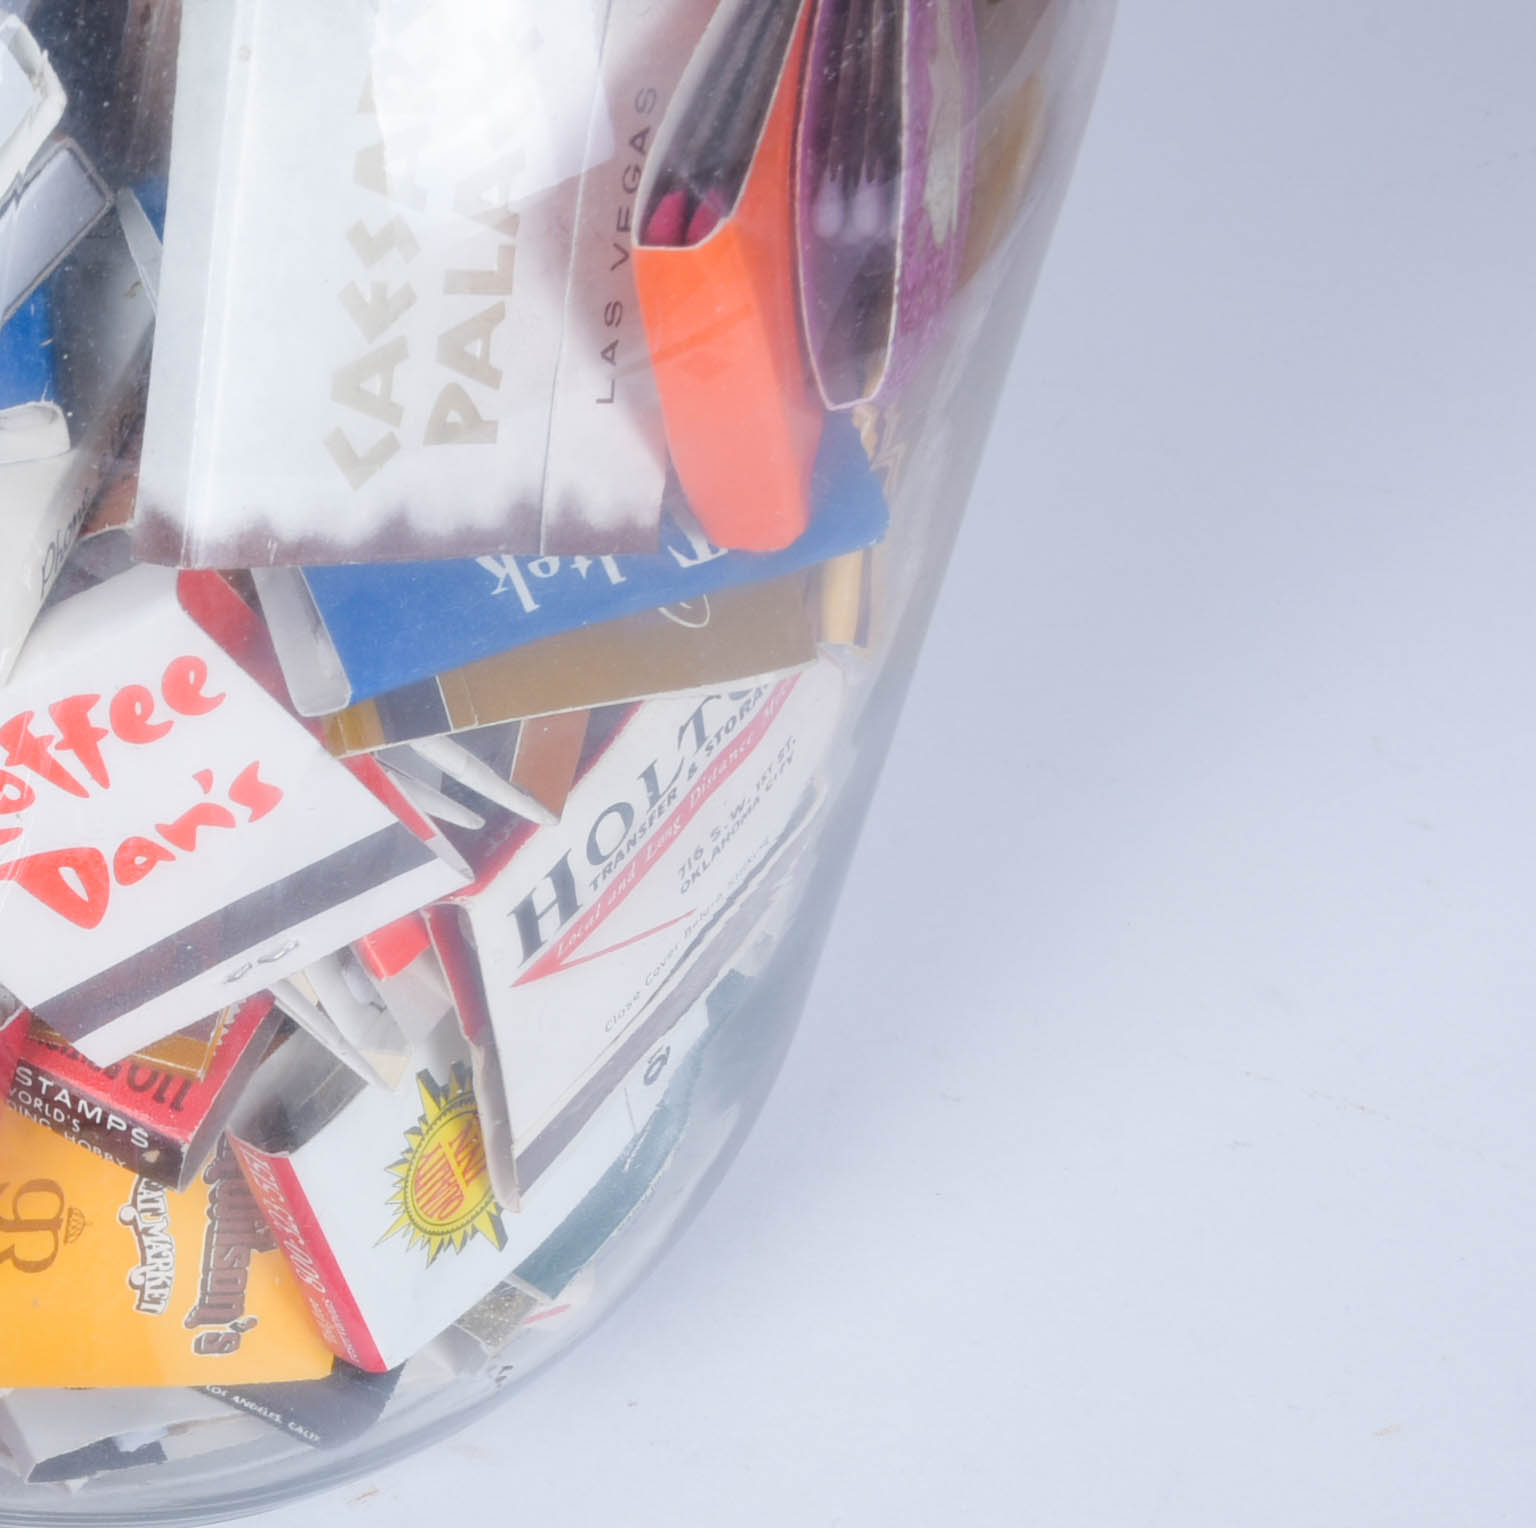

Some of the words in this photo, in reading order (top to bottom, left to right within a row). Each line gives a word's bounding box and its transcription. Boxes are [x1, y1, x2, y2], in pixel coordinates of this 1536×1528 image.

[595, 299, 623, 405] LAS
[610, 87, 656, 271] VEGAS
[589, 787, 678, 892] TRANSFER
[680, 797, 760, 894] OKLAHOMA
[604, 992, 640, 1032] Close
[644, 948, 680, 986] Cover
[15, 1065, 149, 1150] STAMPS
[141, 1215, 176, 1315] MARKET
